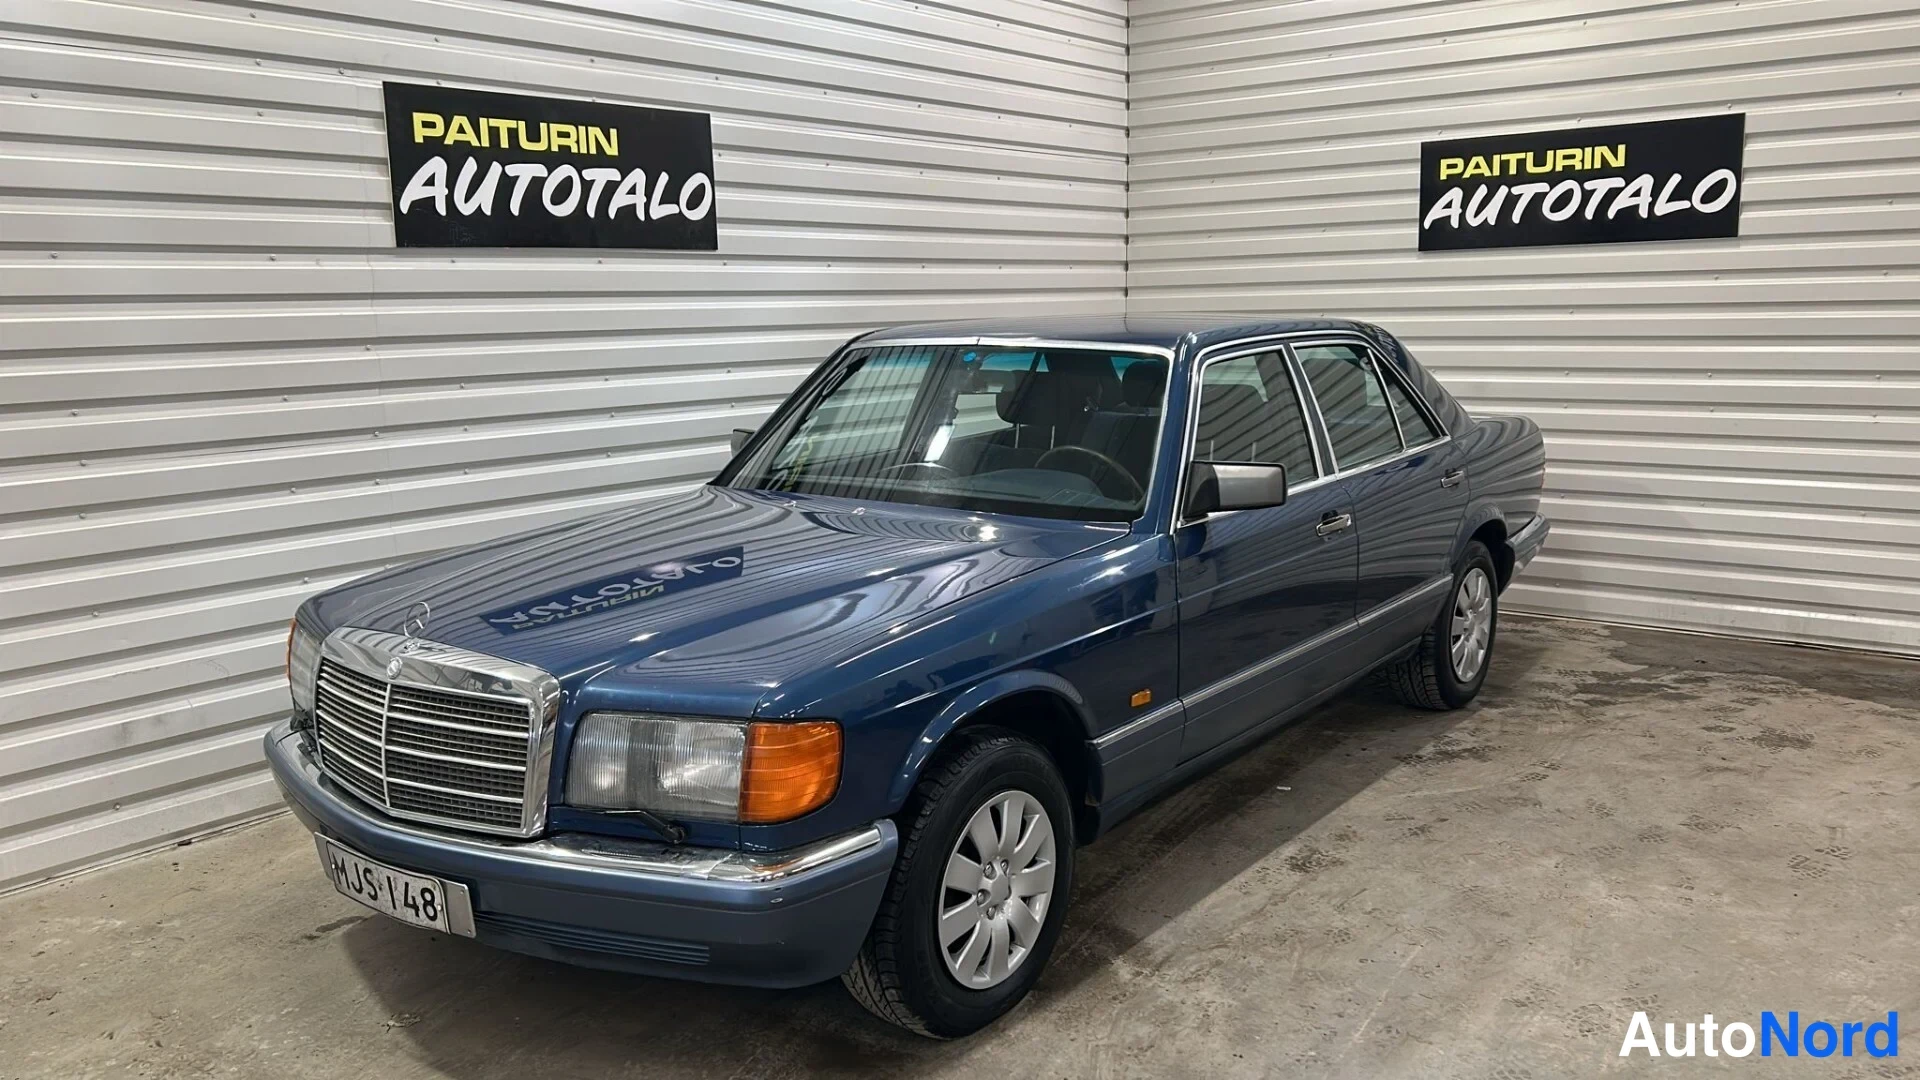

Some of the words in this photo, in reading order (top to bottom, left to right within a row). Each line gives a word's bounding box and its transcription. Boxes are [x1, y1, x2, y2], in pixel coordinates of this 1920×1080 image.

[412, 112, 619, 156] PAITURIN
[399, 156, 713, 221] AUTOTALO
[1439, 144, 1627, 180] PAITURIN
[1423, 168, 1737, 230] AUTOTALO
